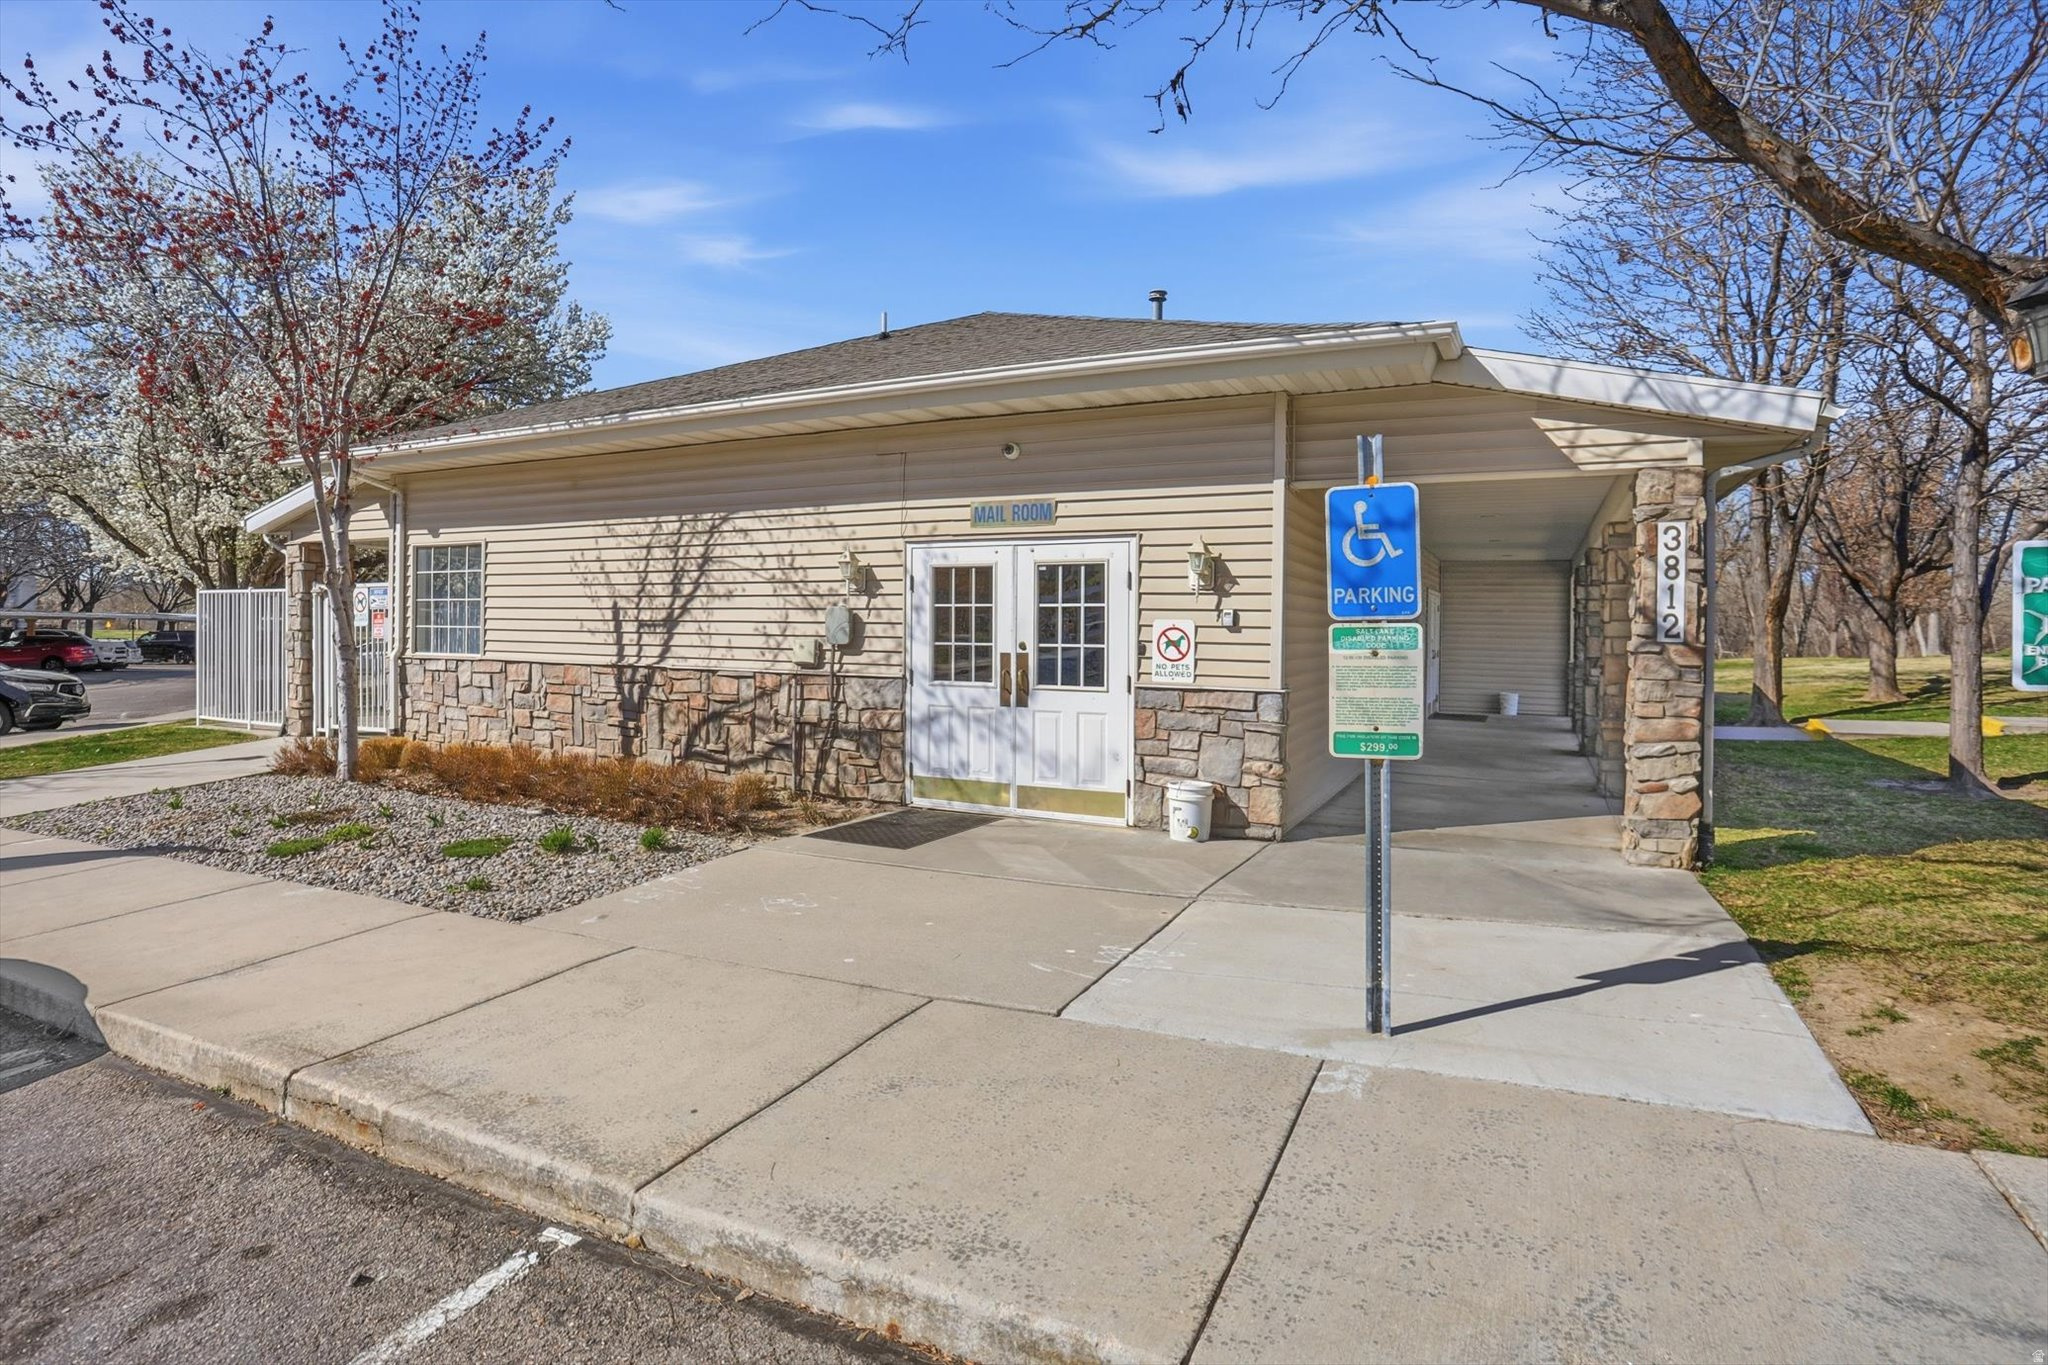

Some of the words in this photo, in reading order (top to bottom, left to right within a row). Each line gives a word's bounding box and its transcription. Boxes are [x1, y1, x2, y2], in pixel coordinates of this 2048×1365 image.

[974, 505, 1006, 523] MAIL
[1012, 503, 1053, 522] ROOM
[1662, 525, 1681, 639] 3812
[1333, 586, 1415, 605] PARKING
[1340, 635, 1375, 643] DISABLED
[1377, 635, 1411, 643] PARKING
[1359, 742, 1399, 752] $299.00
